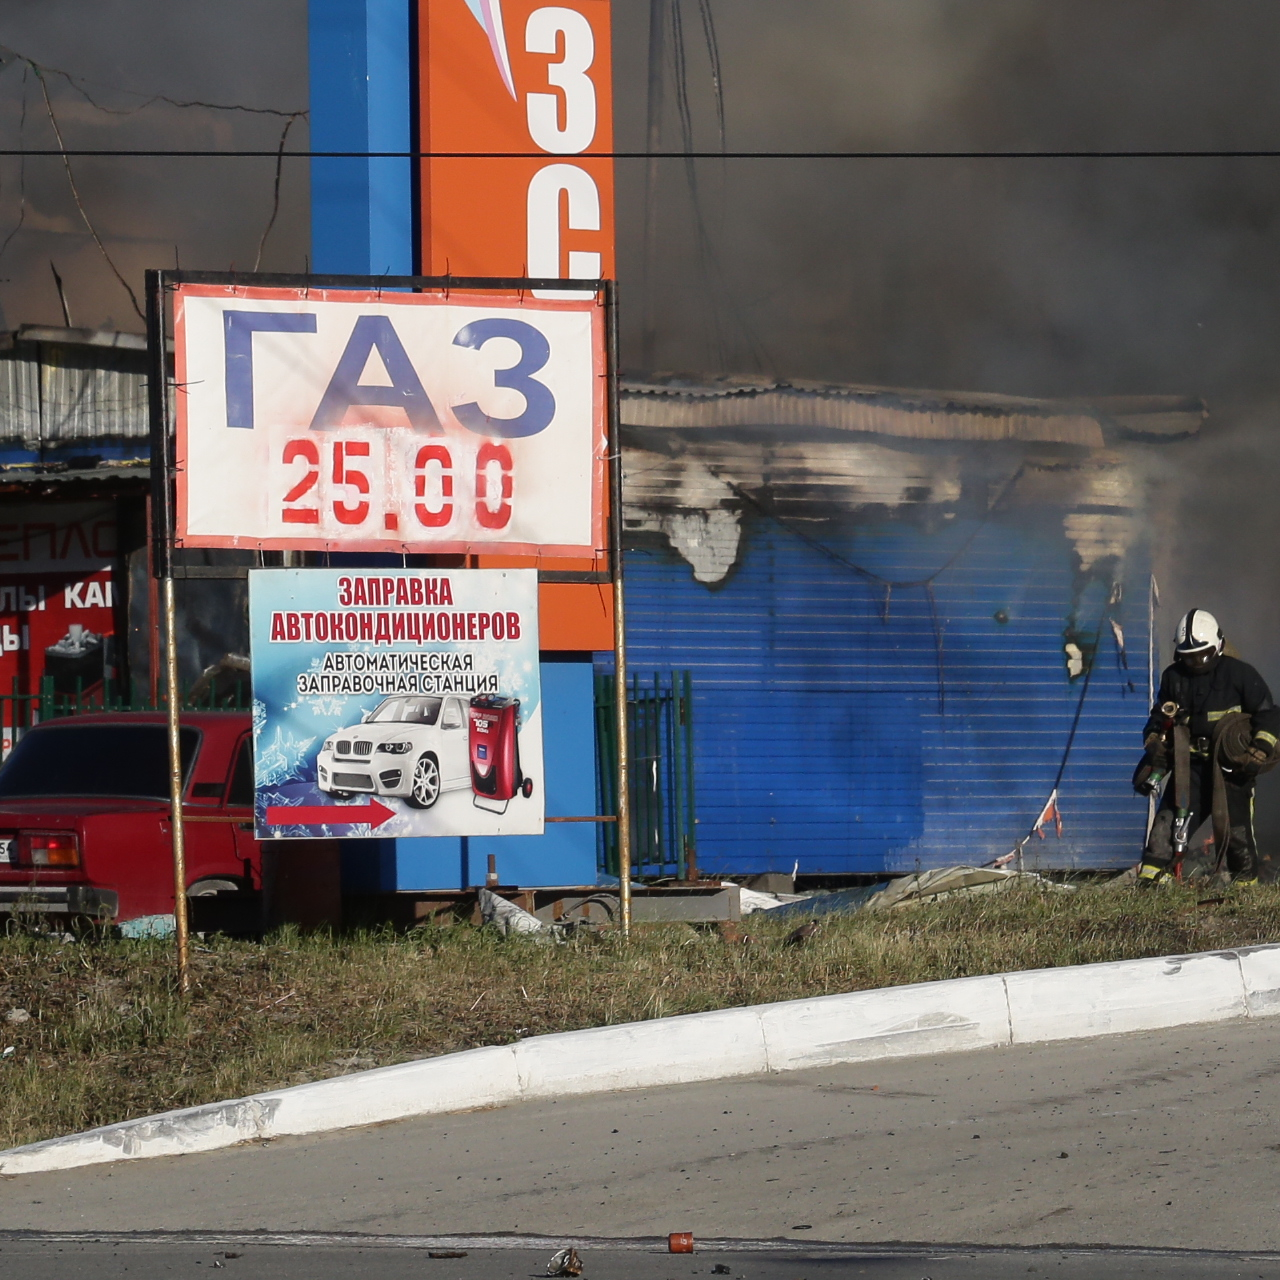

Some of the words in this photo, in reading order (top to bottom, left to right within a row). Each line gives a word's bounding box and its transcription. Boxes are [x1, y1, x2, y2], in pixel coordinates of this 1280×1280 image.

[221, 309, 557, 439] ГАЗ
[281, 439, 514, 531] 25.00
[338, 576, 454, 607] ЗАПРАВКА
[270, 611, 522, 646] АВТОКОНДИЦИОНЕРОВ
[323, 652, 474, 672] АВТОМАТИЧЕСКАЯ
[297, 674, 418, 693] ЗАПРАВОЧНАЯ
[422, 674, 499, 695] СТАНЦИЯ
